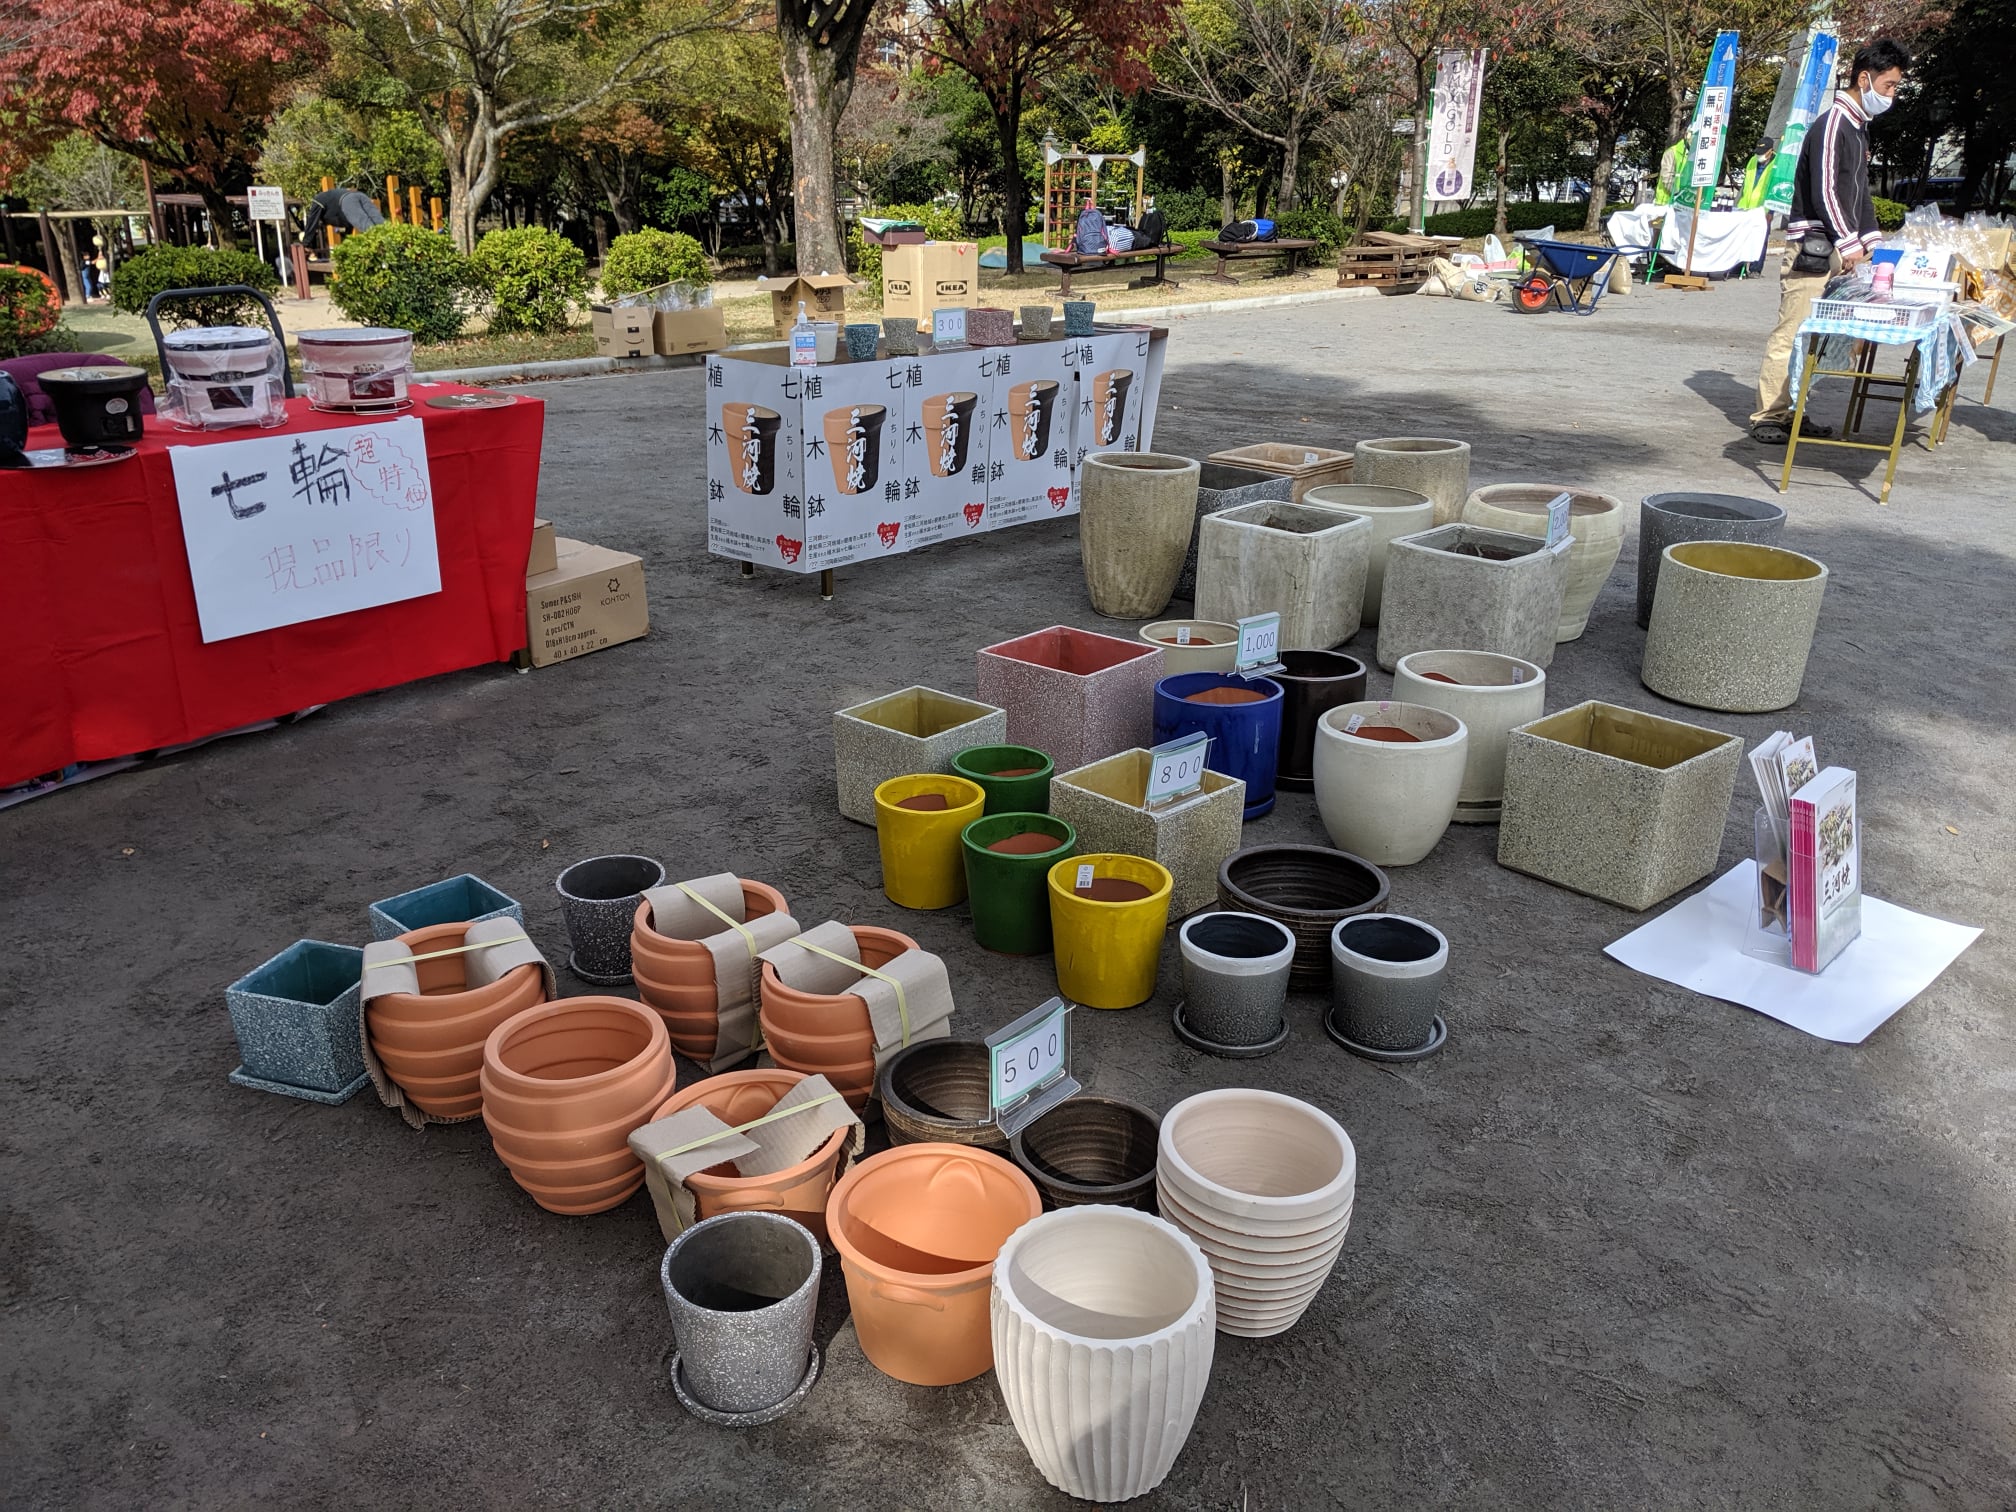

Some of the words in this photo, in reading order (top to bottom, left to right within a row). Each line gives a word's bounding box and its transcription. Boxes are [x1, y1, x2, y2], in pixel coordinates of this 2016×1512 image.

[1444, 108, 1456, 155] GOLD
[1697, 94, 1717, 171] 無料配布
[890, 283, 909, 291] IKEA
[937, 318, 963, 332] 300
[1135, 337, 1148, 358] 七
[885, 366, 902, 389] 七
[978, 356, 993, 378] 七
[1061, 346, 1075, 368] 七
[780, 374, 799, 400] 七
[1058, 384, 1068, 435] しちりん
[1100, 372, 1118, 442] 三河焼
[1129, 373, 1141, 422] しちりん
[708, 363, 725, 503] 植木鉢
[889, 407, 897, 465] しちりん
[904, 363, 924, 500] 植木鉢
[939, 395, 959, 473] 三河焼
[977, 394, 986, 449] しちりん
[989, 353, 1012, 482] 植木鉢
[1021, 383, 1042, 457] 三河焼
[741, 407, 762, 492] 三河焼
[785, 417, 795, 479] しちりん
[804, 374, 827, 520] 植木鉢
[846, 407, 868, 490] 三河焼
[1053, 448, 1068, 470] 輪
[211, 438, 351, 520] 七輪
[884, 480, 901, 503] 輪
[971, 463, 986, 485] 輪
[782, 494, 802, 520] 輪
[260, 528, 411, 594] 現品限り
[545, 628, 550, 637] 4
[550, 621, 575, 636] pcs/CTN
[553, 650, 562, 659] 40
[570, 645, 578, 655] 40
[586, 640, 595, 650] 22
[599, 637, 608, 645] cm
[1245, 631, 1276, 654] 1,000
[1160, 755, 1201, 784] 800
[1823, 862, 1851, 905] 三河焼
[1004, 1033, 1057, 1083] 500
